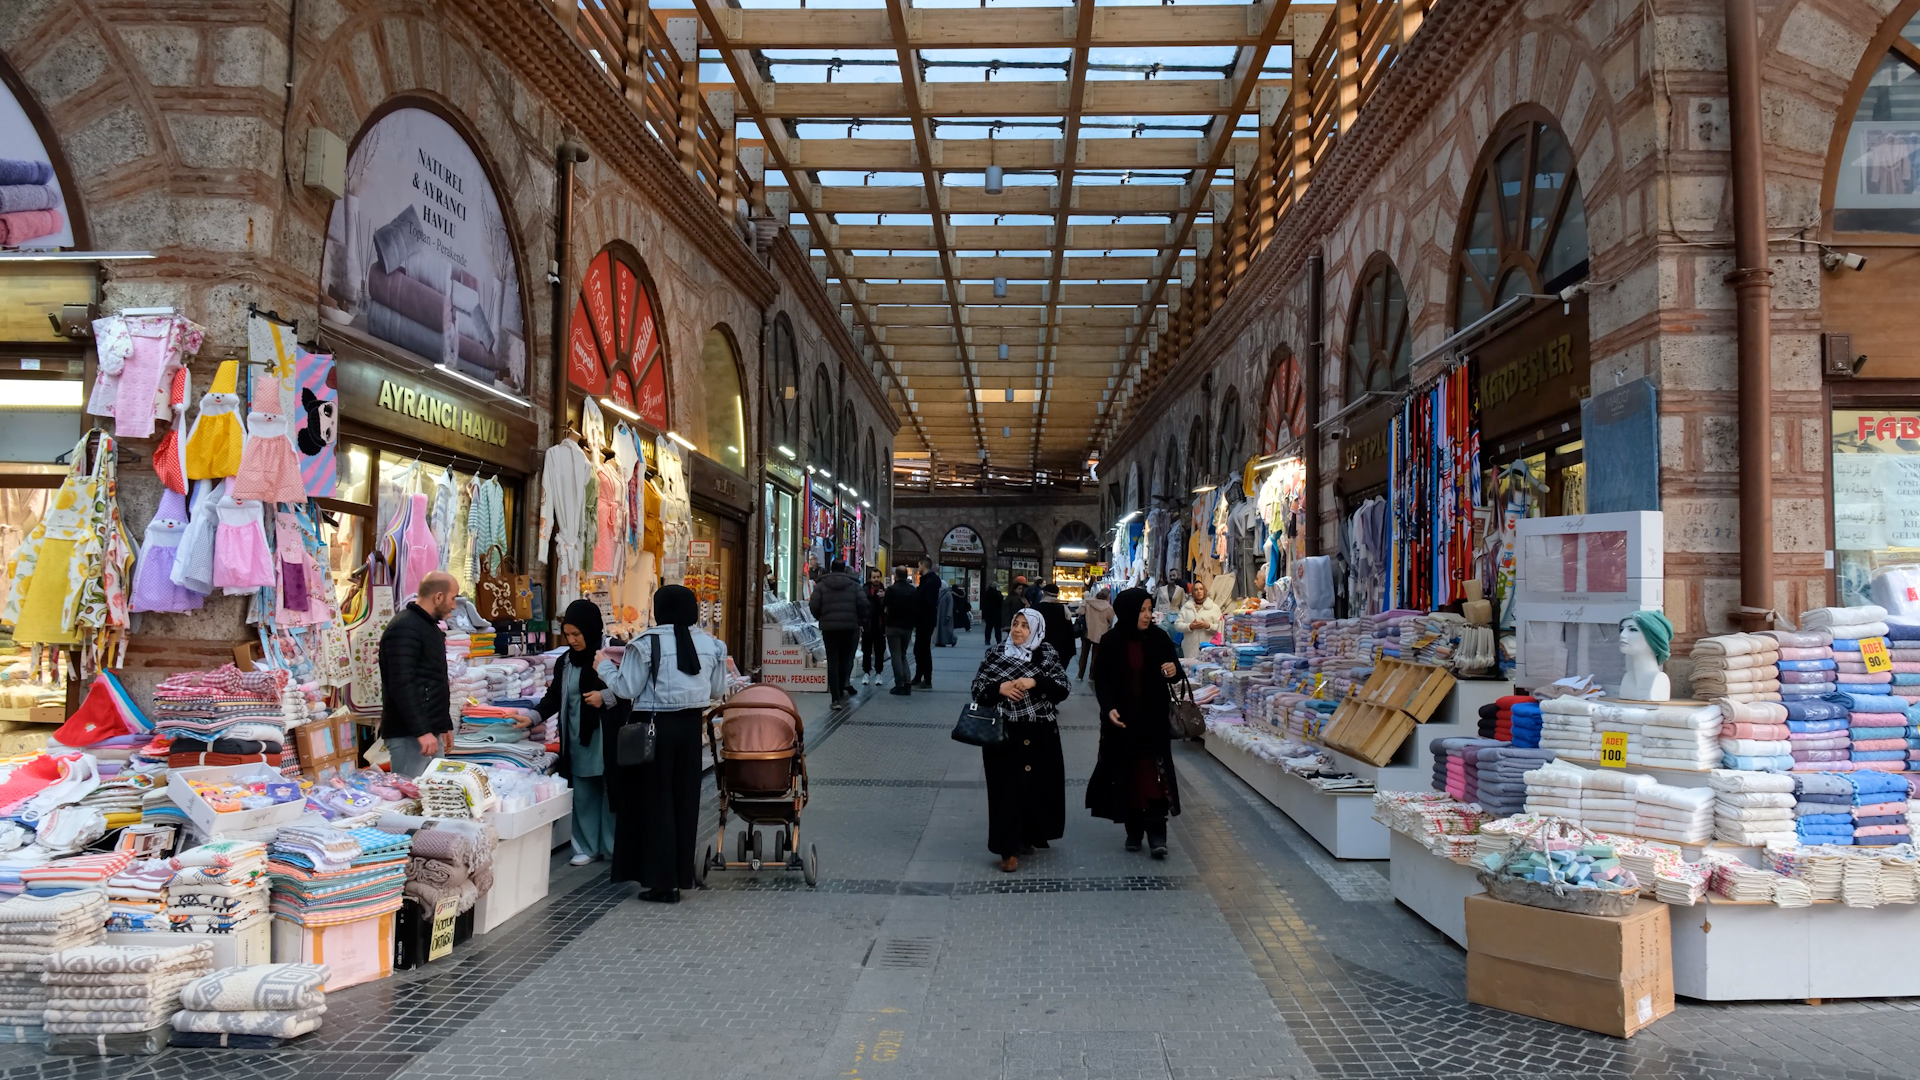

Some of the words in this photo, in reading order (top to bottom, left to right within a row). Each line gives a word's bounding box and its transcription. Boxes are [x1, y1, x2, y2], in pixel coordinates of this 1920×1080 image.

[418, 147, 464, 195] NATUREL
[412, 172, 420, 189] &
[422, 179, 467, 221] AYRANCI
[423, 204, 457, 239] HAVLU
[408, 220, 431, 246] Toptan
[436, 238, 468, 268] Perakende
[615, 374, 628, 392] Nur
[1480, 333, 1574, 409] KARDEŞLER
[378, 379, 458, 432] AYRANCI
[460, 408, 508, 448] HAVLU
[1864, 642, 1883, 654] ADET
[763, 675, 786, 683] TOPTAN
[790, 675, 826, 684] PERAKENDE
[1605, 737, 1624, 746] ADET
